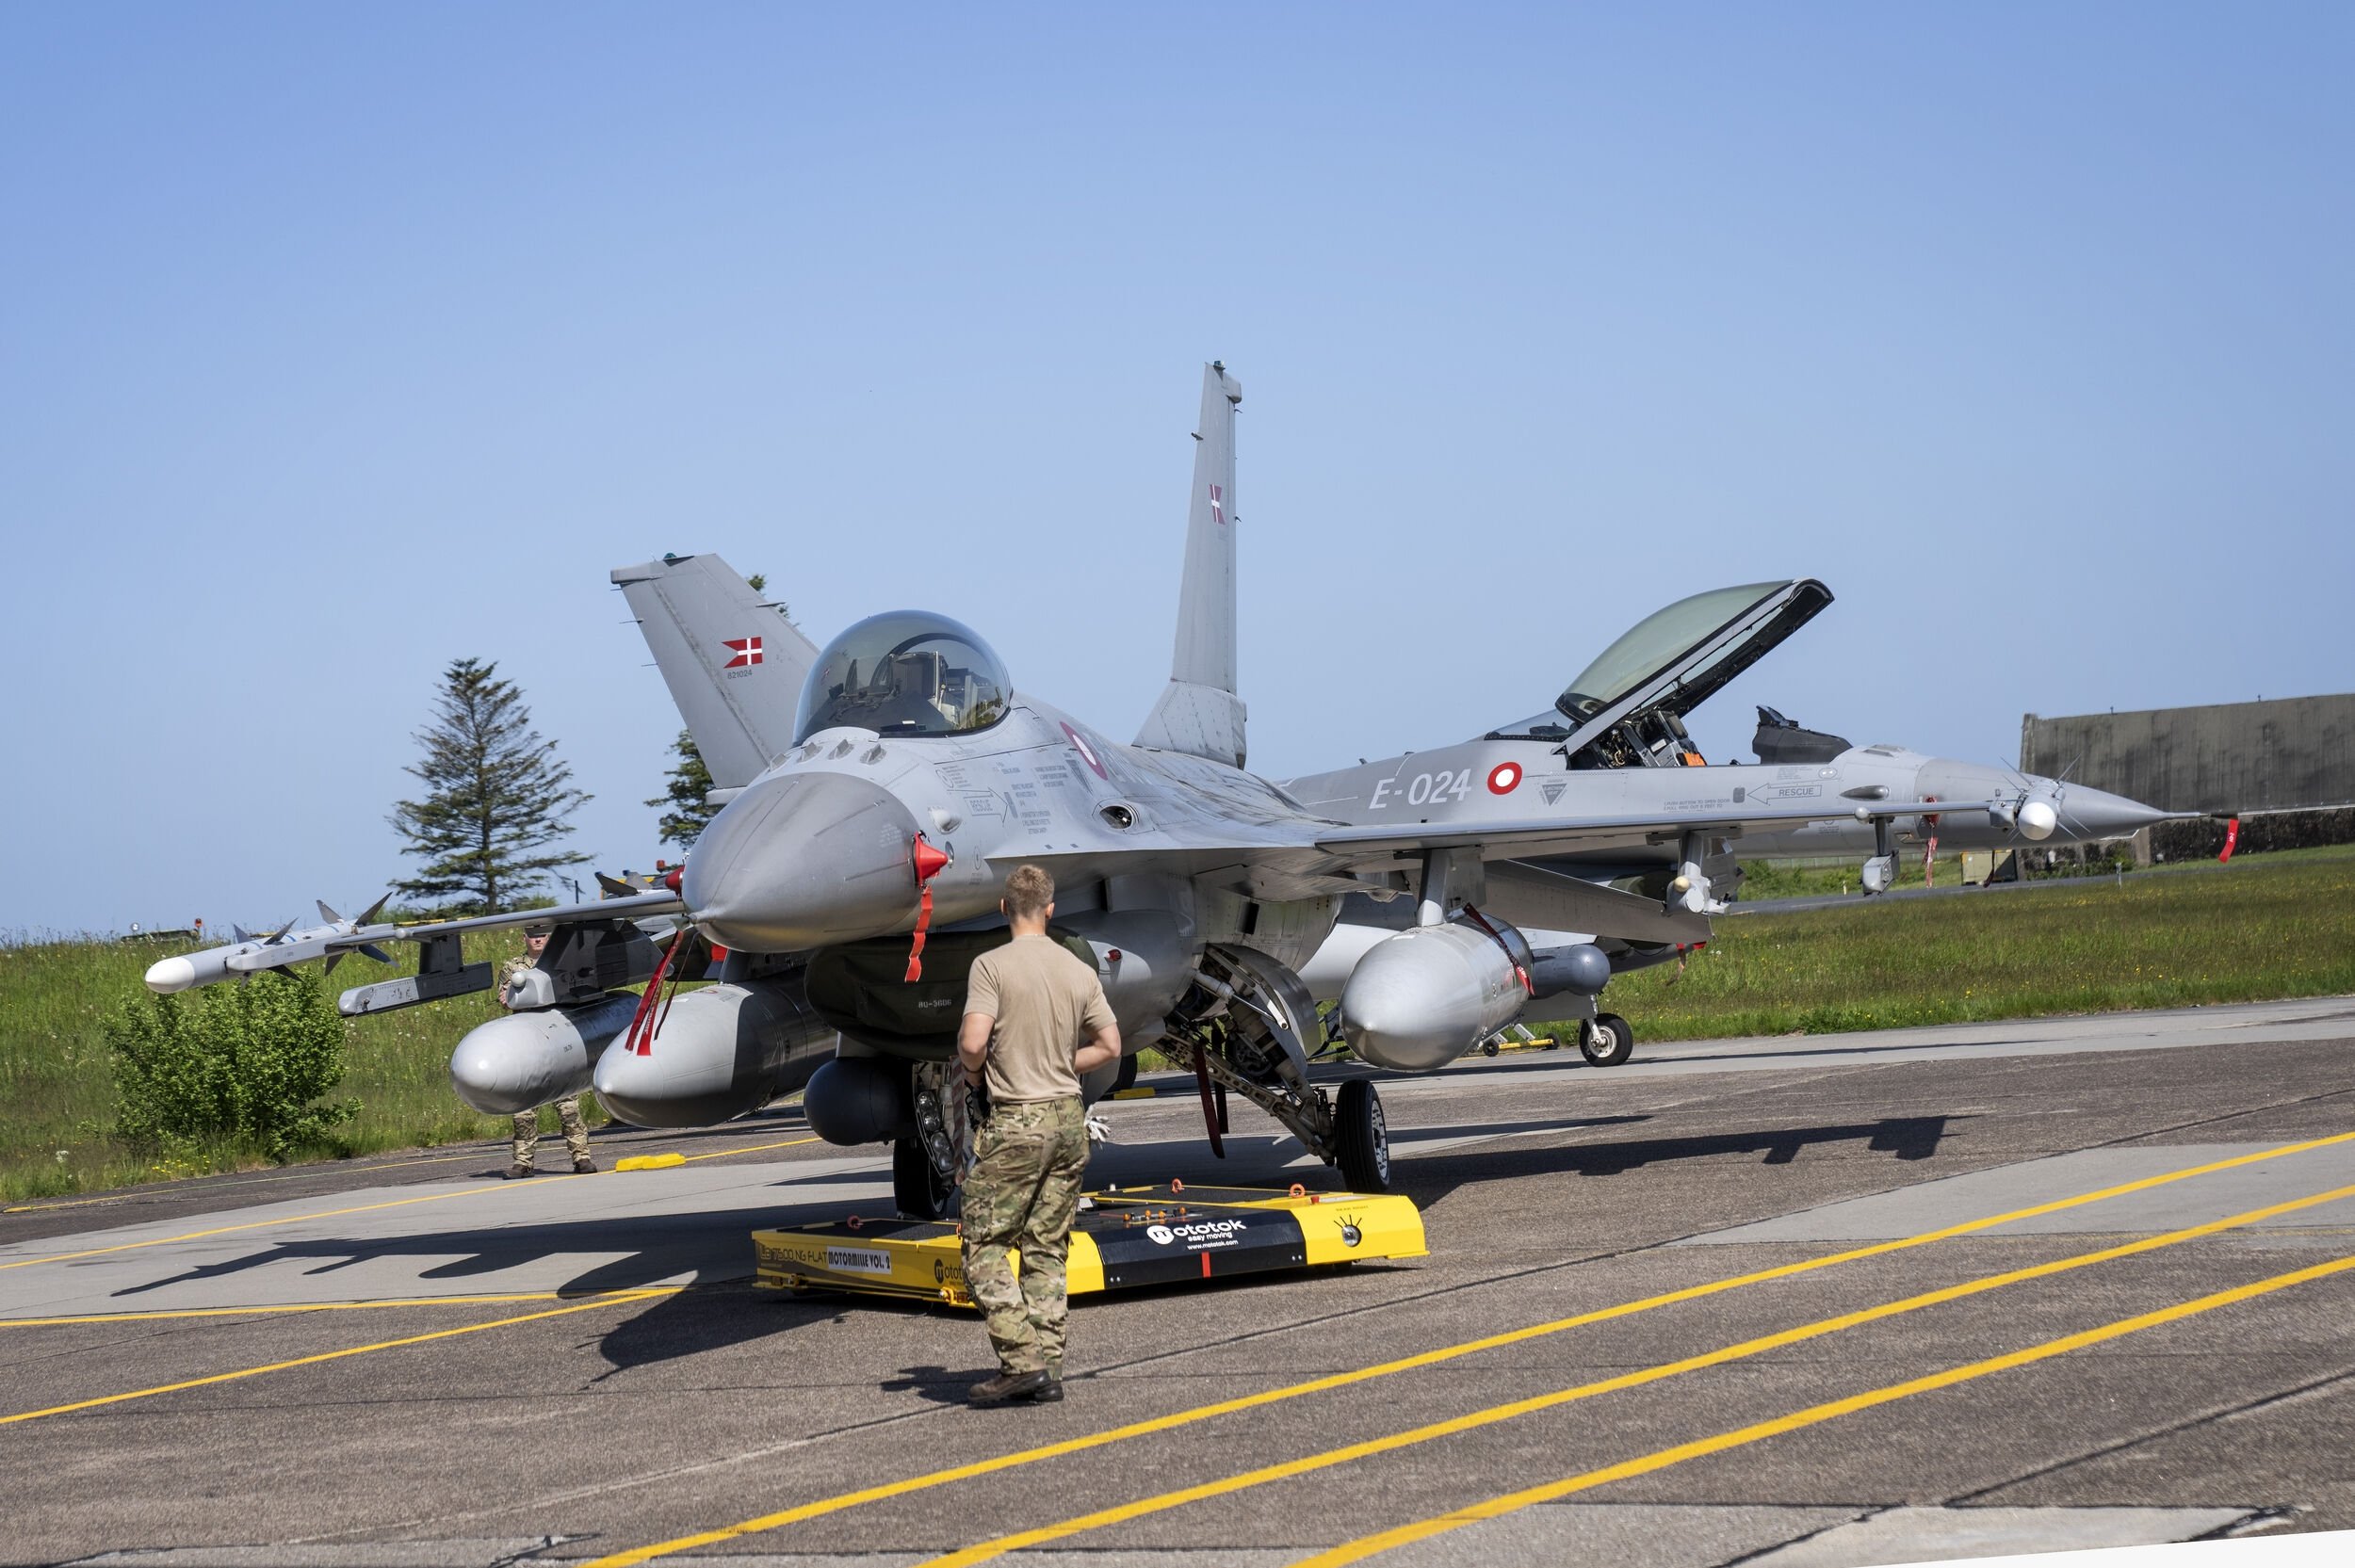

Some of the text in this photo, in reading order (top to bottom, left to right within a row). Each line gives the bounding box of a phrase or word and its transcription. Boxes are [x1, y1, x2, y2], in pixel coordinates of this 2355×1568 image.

[727, 670, 753, 680] 821024
[1368, 768, 1472, 810] E-024
[1778, 787, 1814, 797] RESCUE
[1146, 1219, 1247, 1245] mototok
[1187, 1231, 1233, 1242] easy moving
[1187, 1239, 1239, 1251] www.mototok.com
[807, 1251, 827, 1265] FLAT
[828, 1251, 891, 1269] MOTORMILLE VOL. 2
